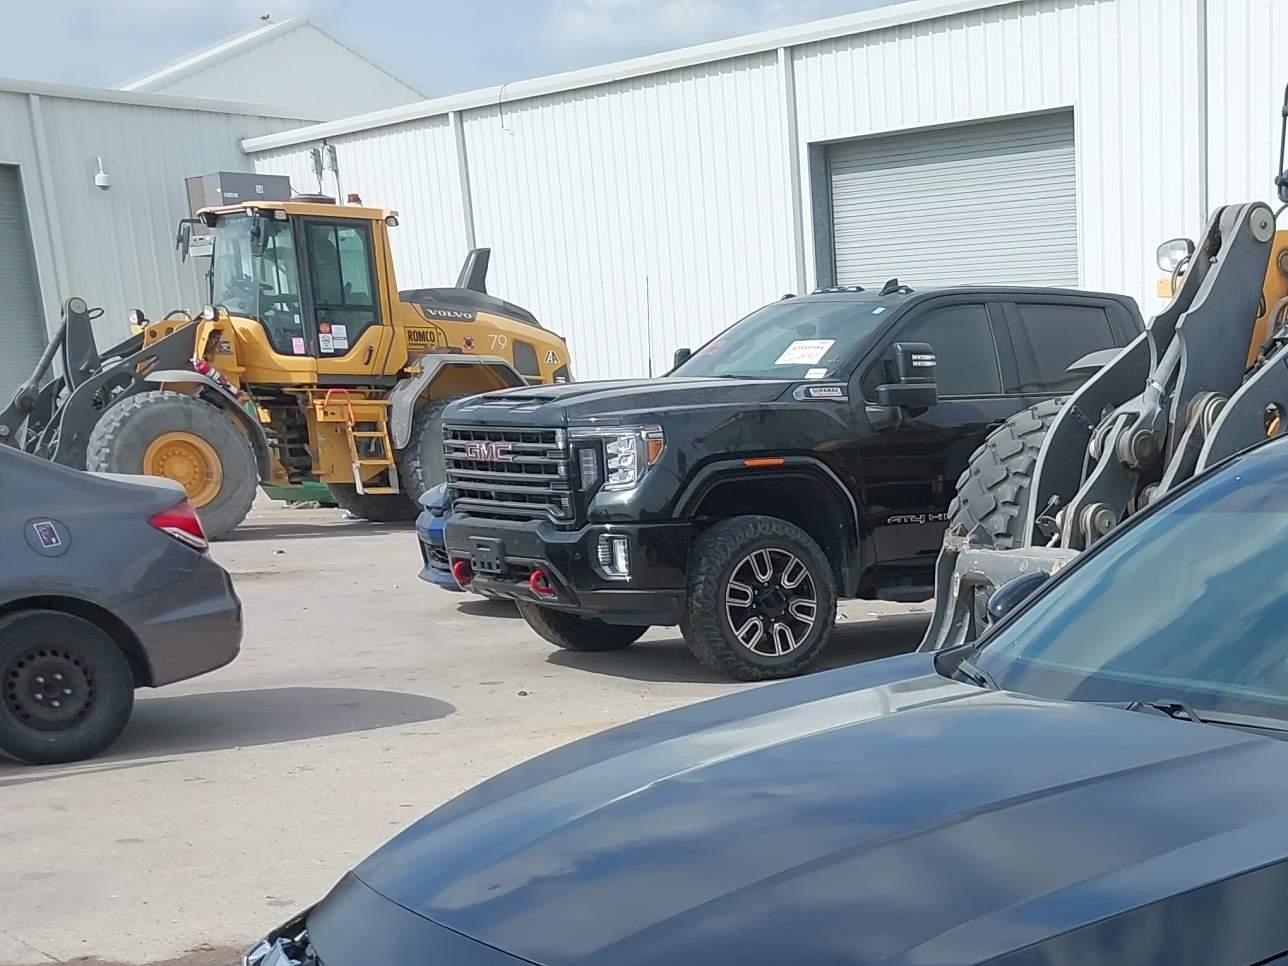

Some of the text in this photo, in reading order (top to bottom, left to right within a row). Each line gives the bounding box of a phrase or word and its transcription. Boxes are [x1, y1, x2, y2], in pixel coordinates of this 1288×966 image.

[427, 308, 473, 320] VOLVO
[407, 330, 436, 343] ROMCO
[488, 334, 508, 350] 79
[465, 441, 513, 462] GMC
[887, 514, 926, 524] AT4
